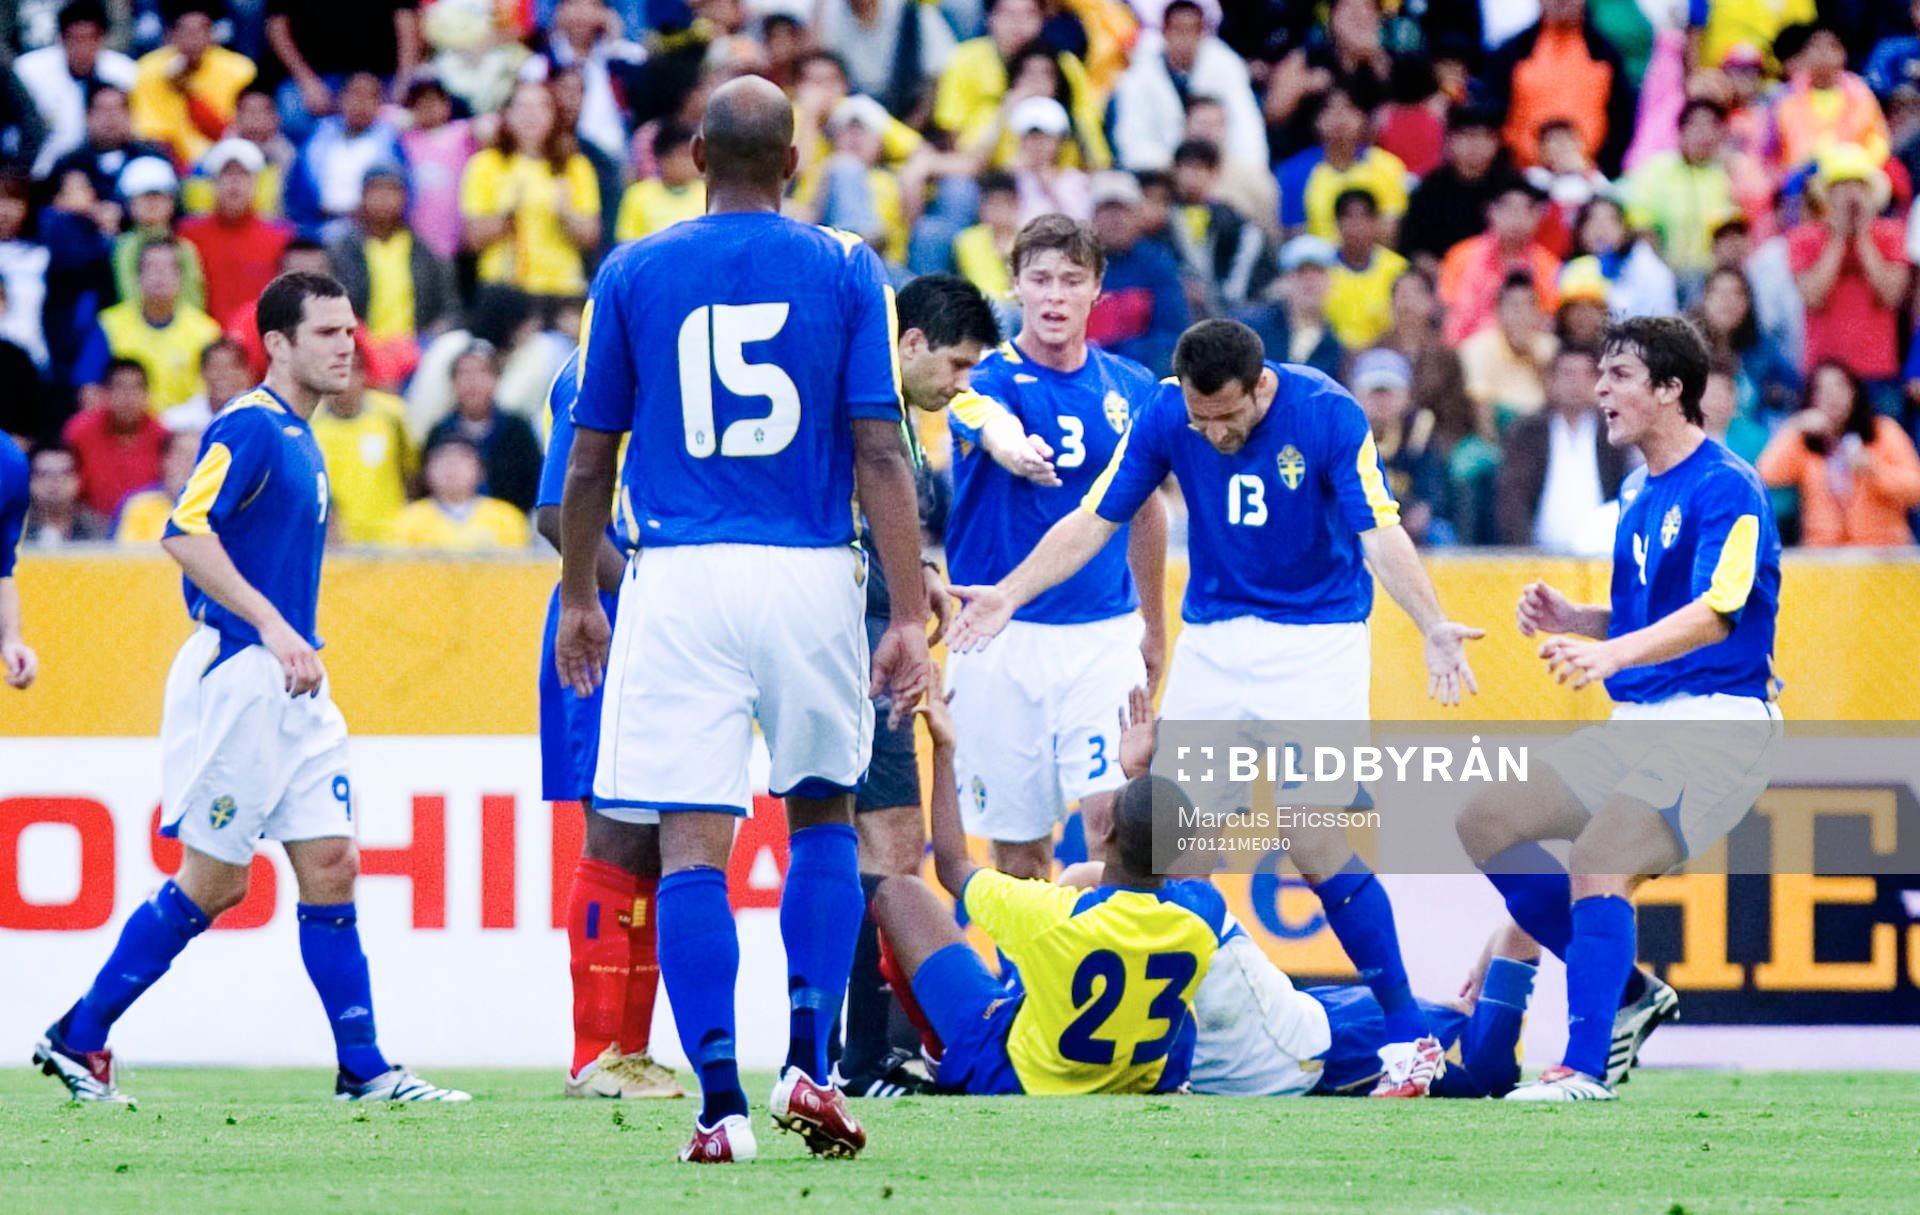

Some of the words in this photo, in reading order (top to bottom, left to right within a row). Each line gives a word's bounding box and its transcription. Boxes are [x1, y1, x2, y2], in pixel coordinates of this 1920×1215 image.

[678, 302, 801, 459] 15
[1056, 415, 1086, 468] 3
[1228, 473, 1268, 527] 13
[1087, 734, 1107, 780] 3
[332, 775, 351, 822] 9
[1058, 949, 1198, 1066] 23
